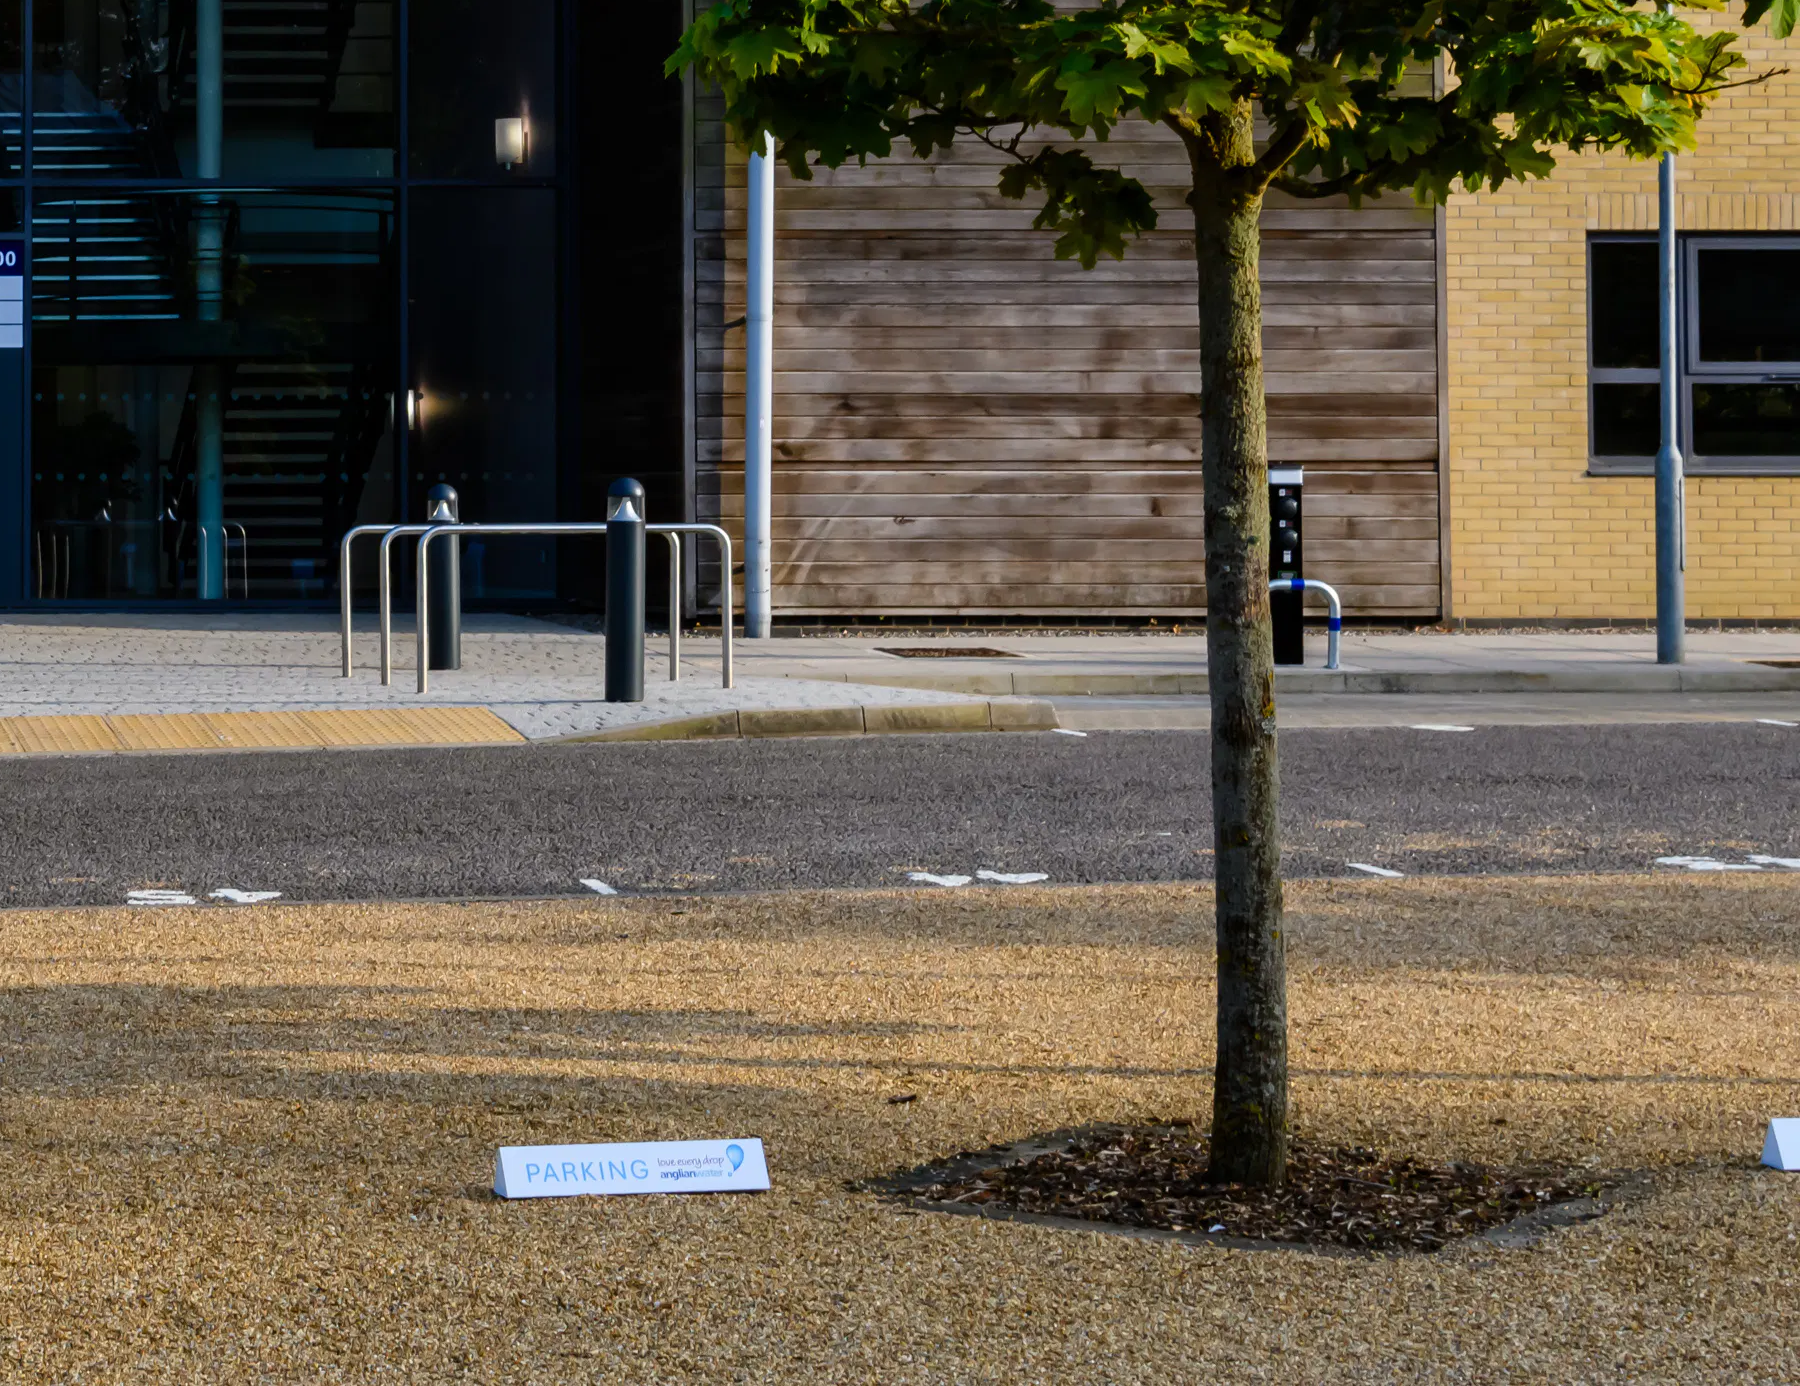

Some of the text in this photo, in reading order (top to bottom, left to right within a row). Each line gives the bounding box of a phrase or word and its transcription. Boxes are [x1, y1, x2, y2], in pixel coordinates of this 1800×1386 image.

[657, 1157, 676, 1167] love
[702, 1154, 725, 1167] drop
[526, 1159, 650, 1183] PARKING
